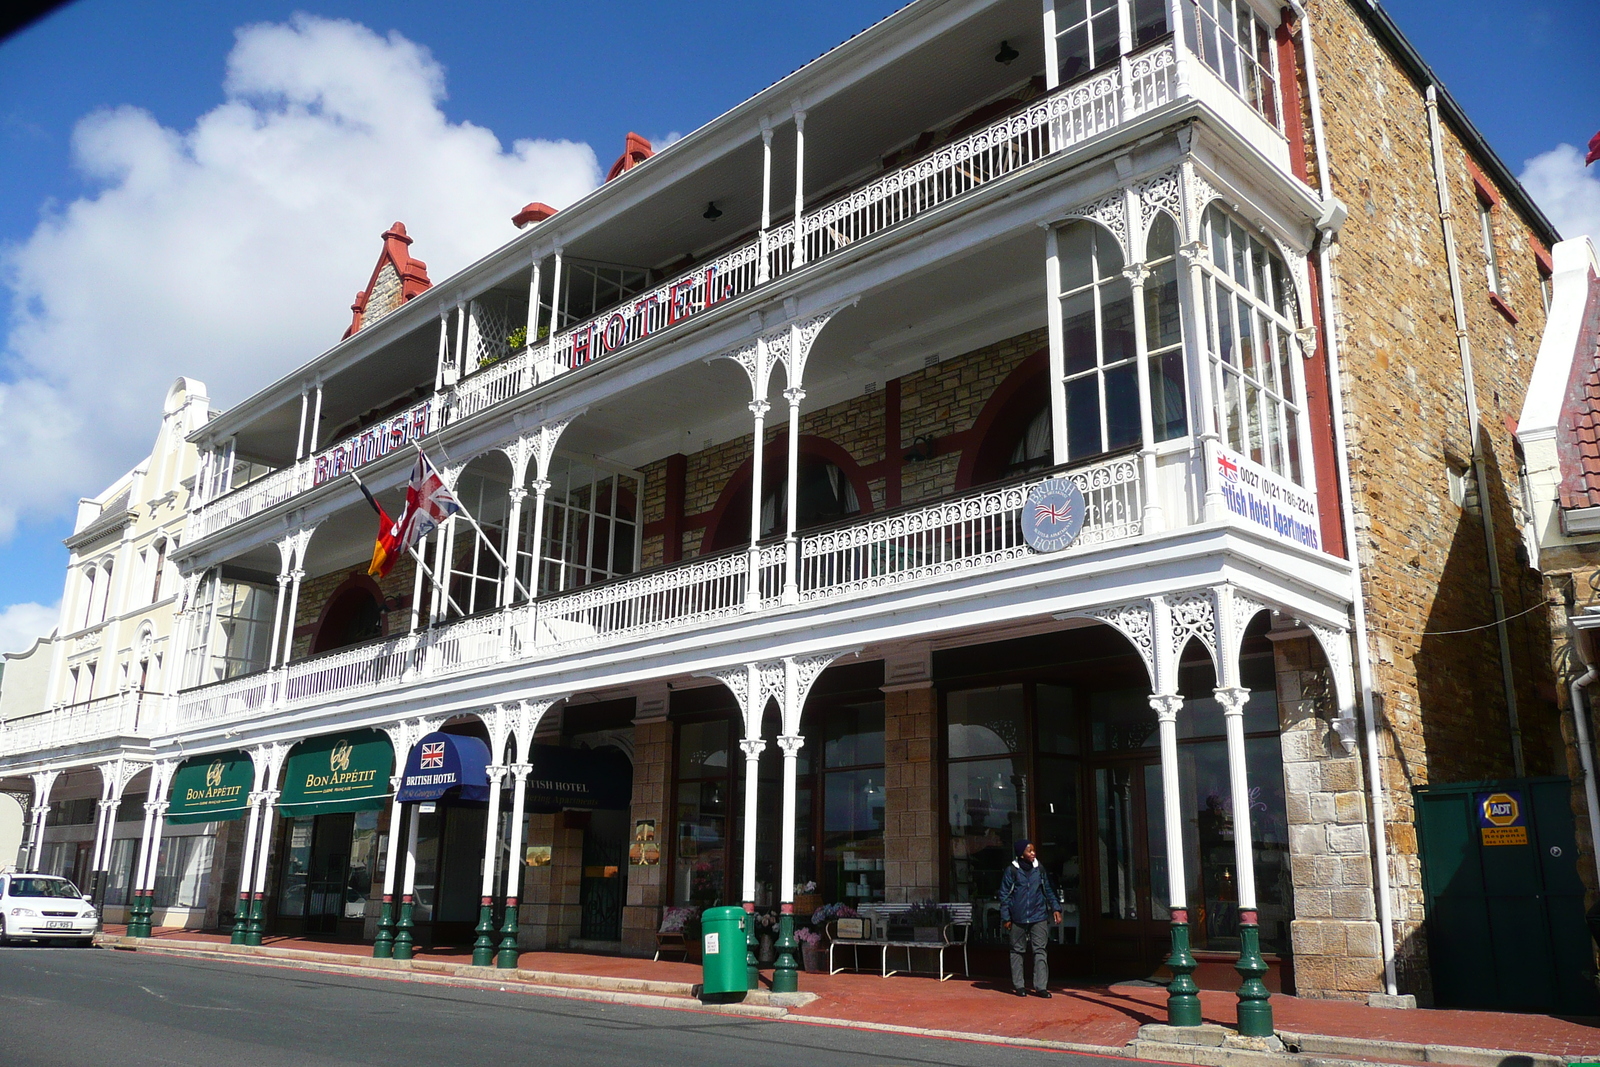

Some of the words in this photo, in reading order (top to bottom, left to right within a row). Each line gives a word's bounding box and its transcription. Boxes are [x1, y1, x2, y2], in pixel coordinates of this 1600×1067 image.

[313, 402, 432, 487] BRITISH
[570, 265, 732, 369] HOTEL
[1028, 479, 1076, 505] BRITISH
[1240, 466, 1259, 489] 0027
[1261, 477, 1280, 500] (0)21
[1282, 488, 1315, 518] 786-2214
[1248, 492, 1272, 529] Hotel
[1272, 504, 1319, 550] Apartments
[1032, 531, 1077, 551] HOTEL
[406, 774, 432, 786] BRITISH
[433, 772, 457, 785] HOTEL
[555, 781, 589, 793] HOTEL
[1492, 803, 1511, 815] ADT
